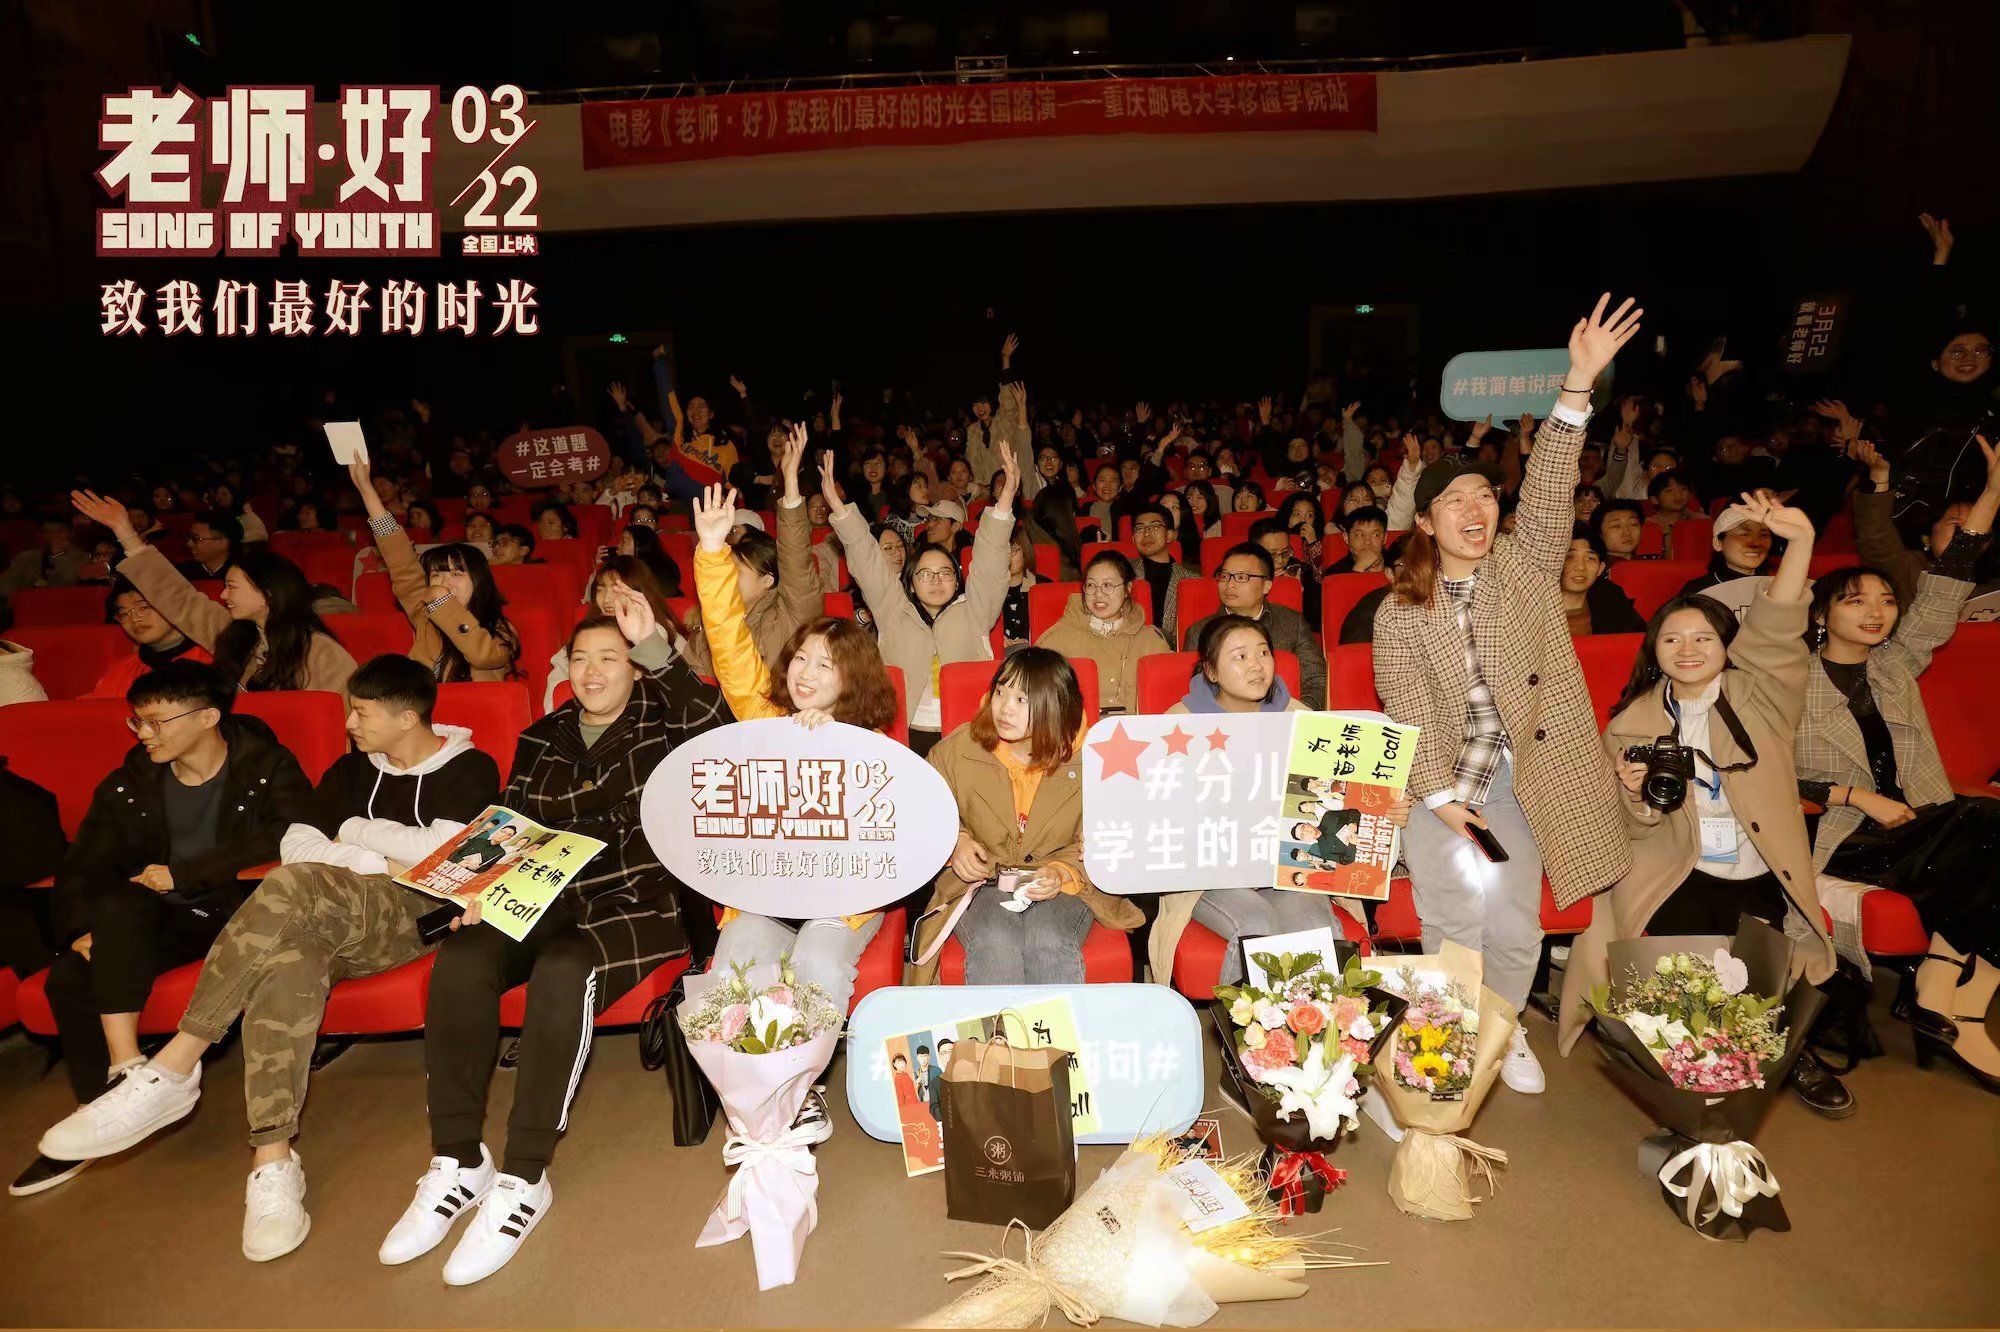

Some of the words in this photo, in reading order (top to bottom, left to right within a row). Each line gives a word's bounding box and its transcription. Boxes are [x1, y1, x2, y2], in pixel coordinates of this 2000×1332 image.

[515, 433, 589, 457] #这道题
[511, 456, 601, 479] 一定会考#
[1307, 737, 1332, 753] 为
[1333, 723, 1363, 776] 苗老师
[1144, 751, 1284, 805] #分儿
[695, 816, 746, 836] SONG
[752, 817, 778, 837] OF
[782, 817, 846, 838] YOUTH
[1091, 815, 1279, 873] 学生的命
[518, 858, 566, 888] 苗老师
[697, 848, 897, 880] 致我们最好的时光
[1032, 1019, 1052, 1047] 为
[1072, 1092, 1090, 1118] all
[974, 1166, 1025, 1183] 三米粥铺
